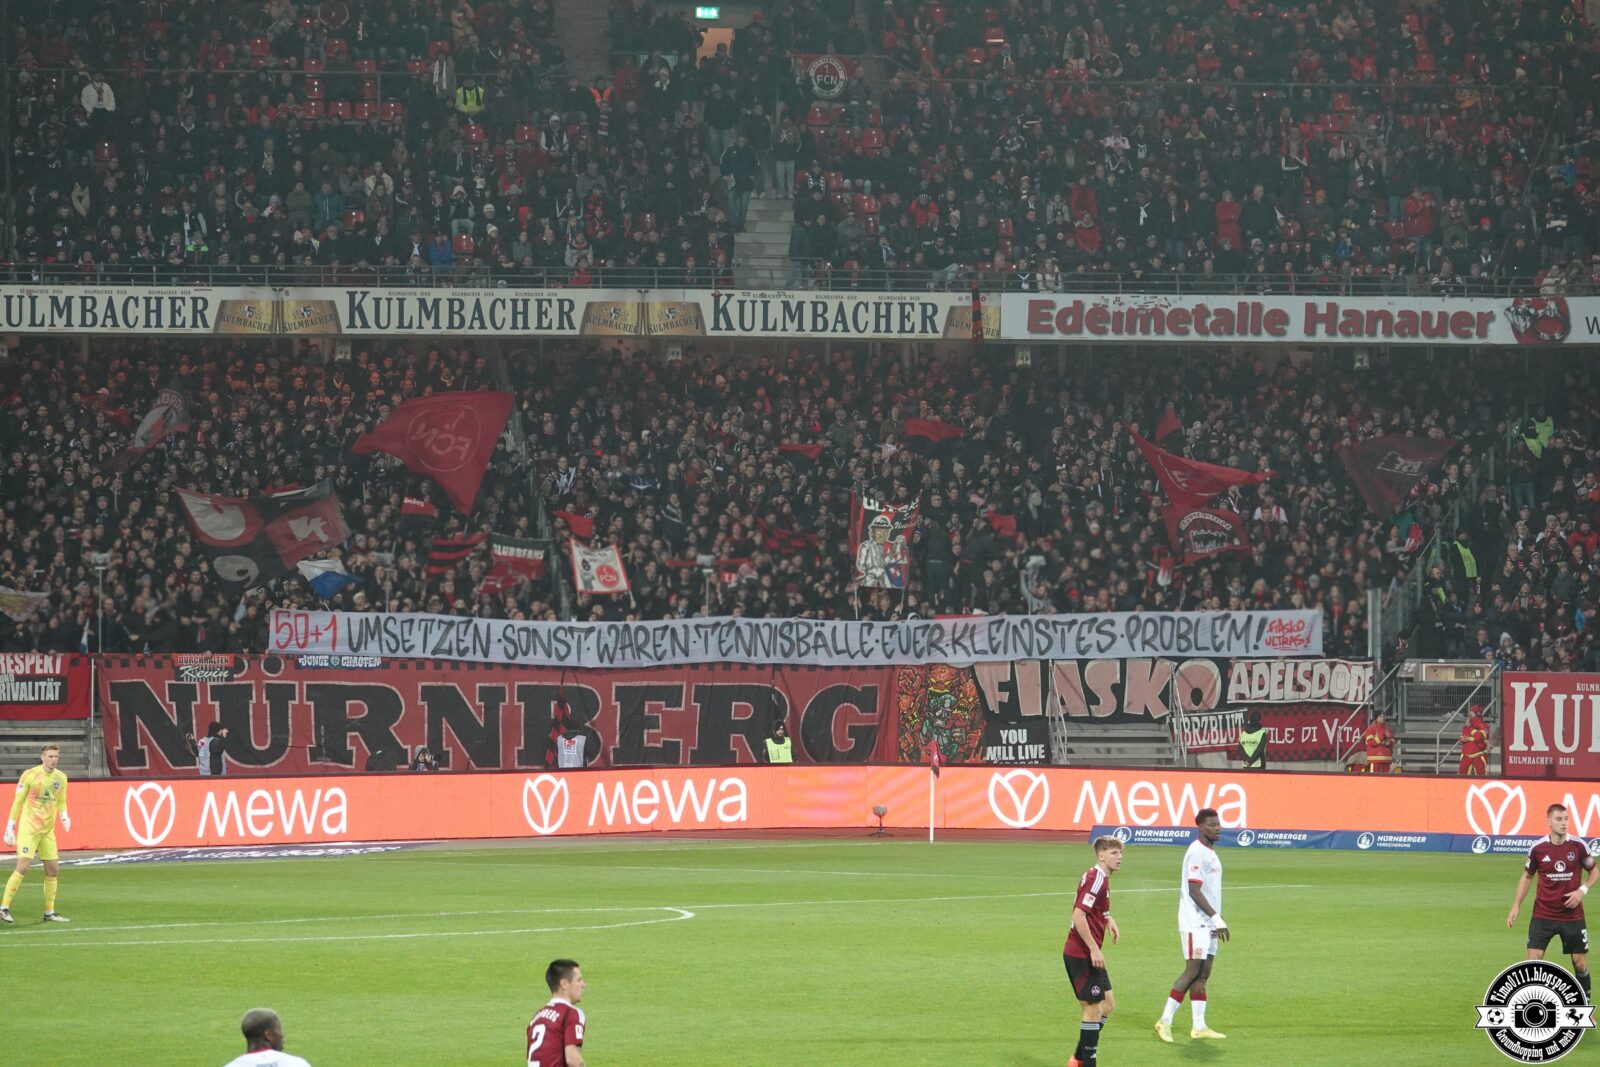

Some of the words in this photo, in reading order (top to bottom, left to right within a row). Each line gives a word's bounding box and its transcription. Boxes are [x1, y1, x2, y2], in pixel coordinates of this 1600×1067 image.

[346, 290, 577, 331] KULMBACHER
[710, 292, 940, 334] KULMBACHER
[1026, 299, 1290, 336] Edelmetalle
[1303, 301, 1495, 338] Hanauer
[221, 311, 273, 332] KULMBACHER
[283, 311, 335, 332] KULMBACHER
[587, 313, 639, 334] KULMBACHER
[647, 313, 700, 334] KULMBACHER
[274, 610, 338, 653] 50+1
[346, 615, 492, 659] UMSETZEN
[502, 623, 596, 662] SONST
[596, 623, 696, 664] WAREN
[696, 620, 874, 660] TENNISBÄLLE
[882, 623, 947, 659] EUER
[952, 617, 1117, 658] KLEINSTES
[1126, 613, 1268, 653] PROBLEM!
[0, 652, 64, 675] RESPEKT
[178, 655, 230, 665] DURCHHALTEN
[299, 654, 329, 667] JUNGE
[341, 655, 381, 668] CHAOTEN
[179, 664, 230, 679] Kevin
[1226, 661, 1374, 701] ADELSDORF
[0, 678, 61, 702] RIVALITÄT
[974, 657, 1222, 719] FIASKO
[108, 654, 882, 771] NÜRNBERG
[1000, 729, 1027, 744] YOU
[1301, 727, 1317, 743] DI
[1018, 744, 1046, 760] LIVE
[1508, 755, 1553, 765] KULMBACHER
[1559, 757, 1575, 766] BIER
[1135, 829, 1191, 839] NÜRNBERGER
[1257, 832, 1307, 841] NÜRNBERGER
[1377, 835, 1427, 844] NÜRNBERGER
[527, 1023, 547, 1067] 2
